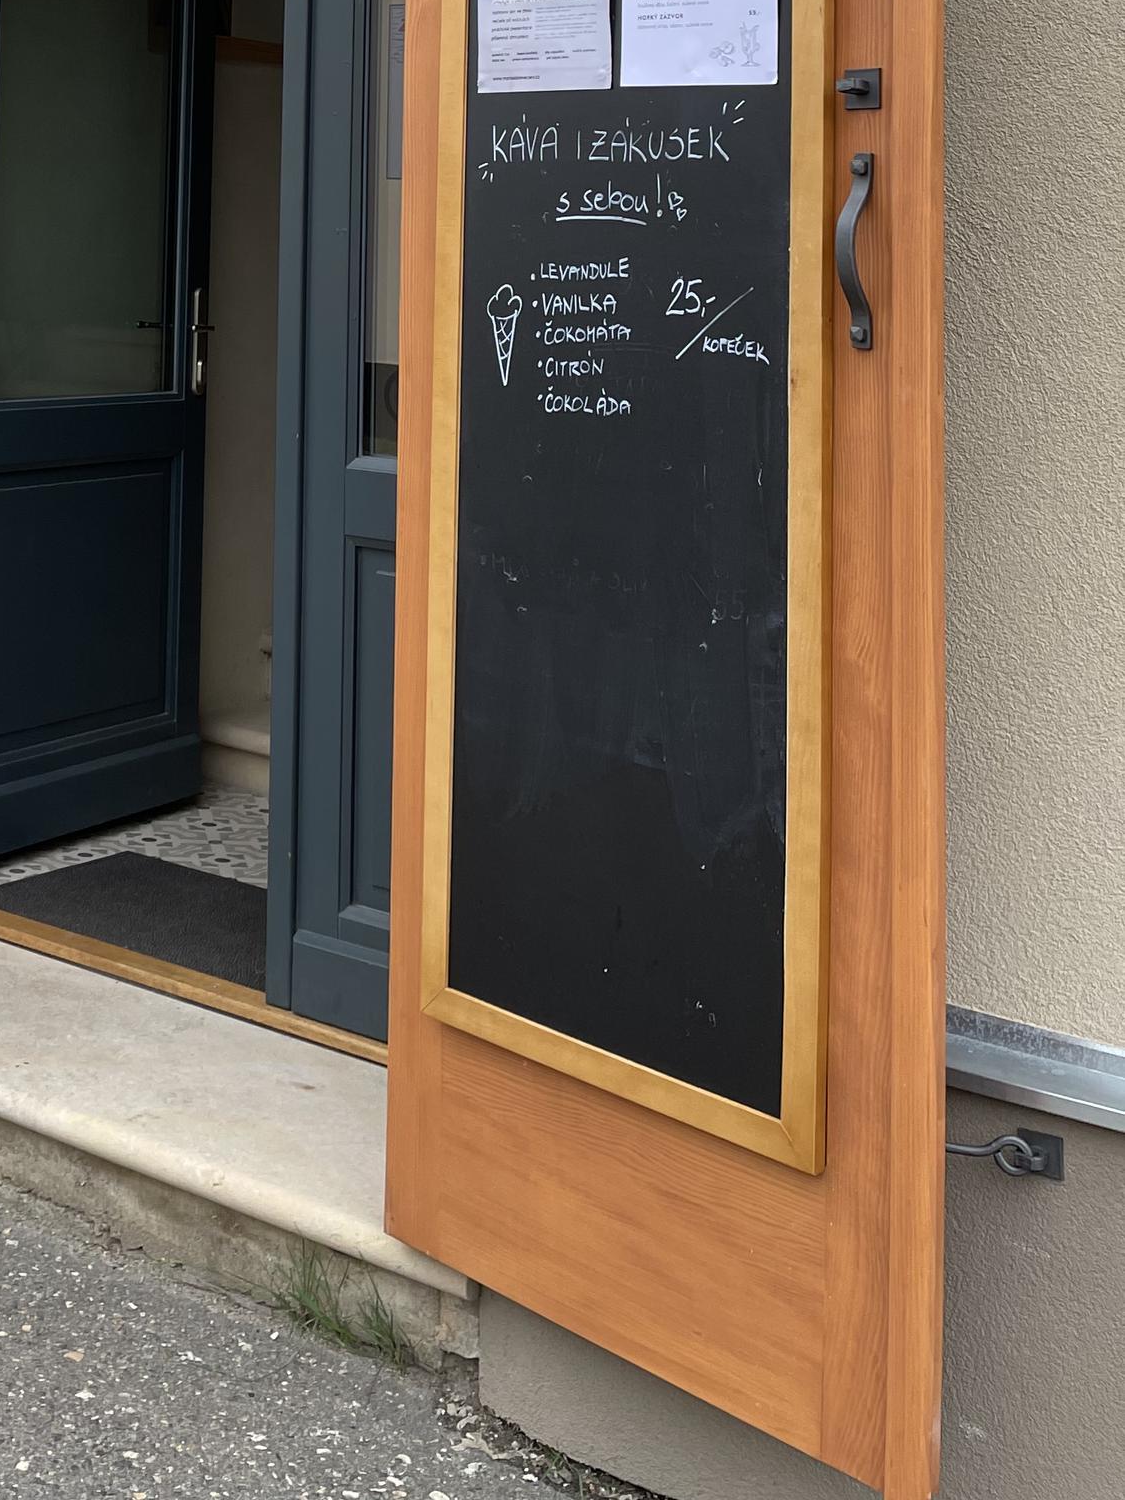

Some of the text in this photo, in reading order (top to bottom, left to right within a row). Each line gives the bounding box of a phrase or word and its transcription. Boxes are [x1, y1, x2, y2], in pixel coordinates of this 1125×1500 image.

[492, 113, 559, 164] KÁVA
[588, 117, 730, 164] ZÁKUSEK
[540, 257, 630, 280] LEVANDULE
[542, 294, 617, 316] VANILKA
[545, 350, 604, 378] CITRÓN
[545, 386, 631, 416] ČOKOLÁDA
